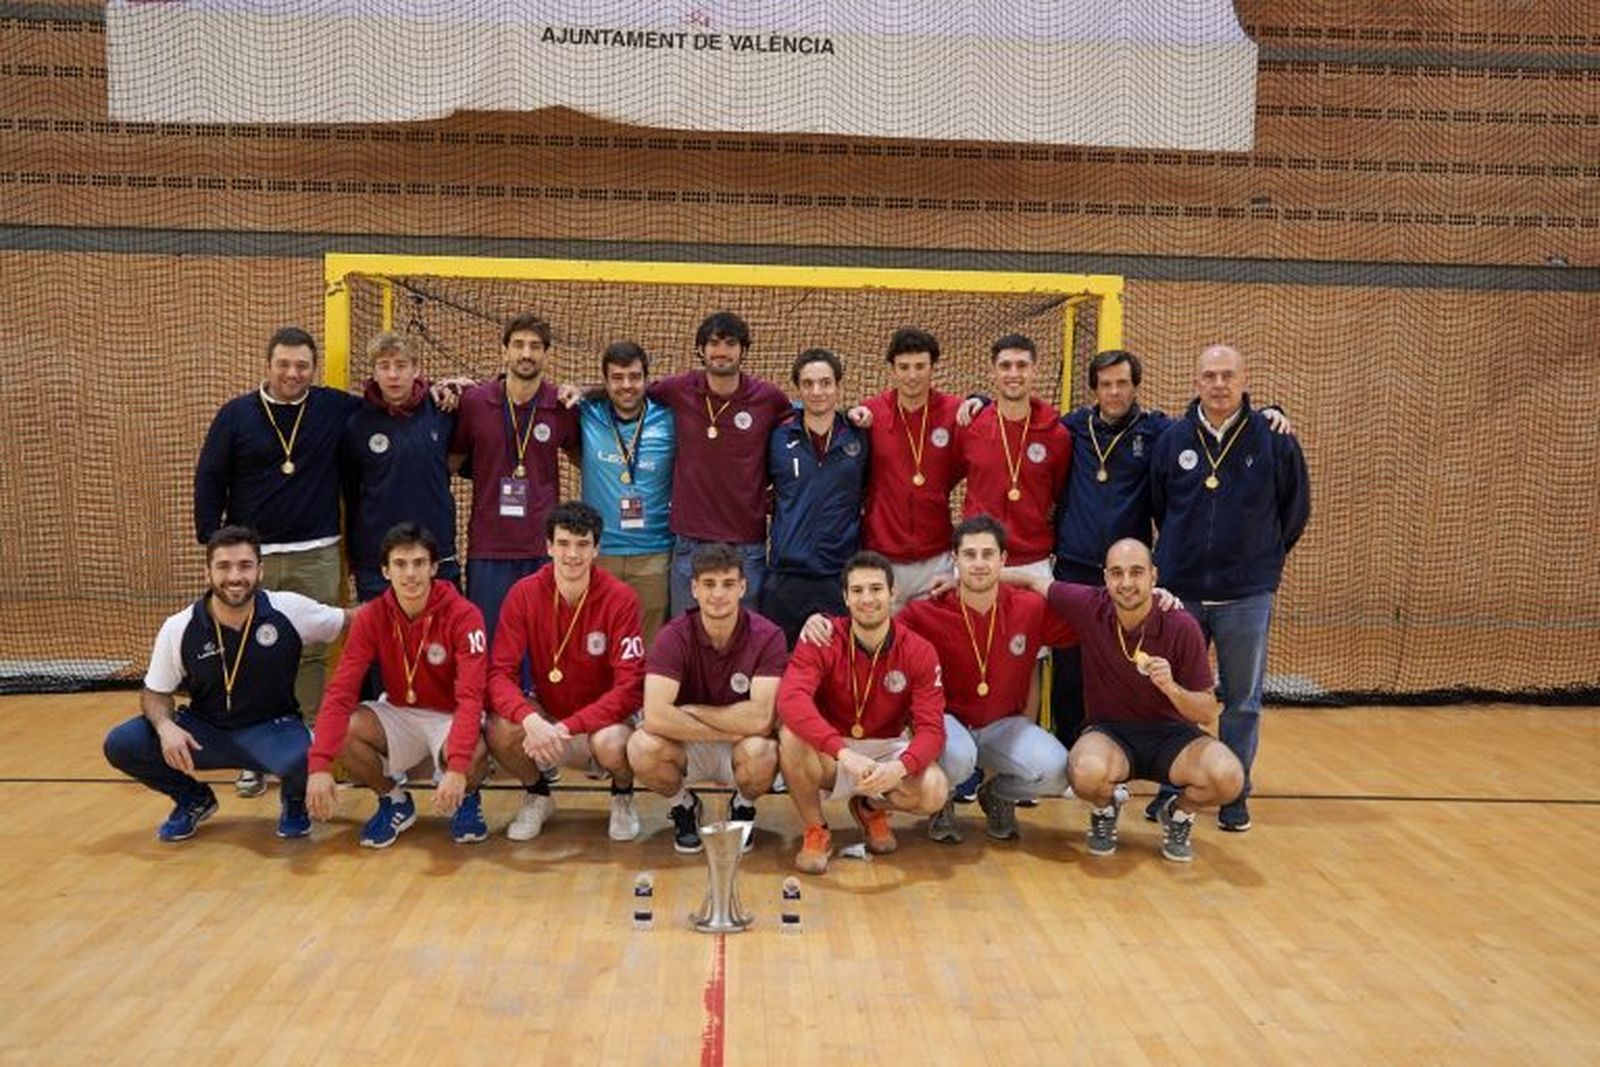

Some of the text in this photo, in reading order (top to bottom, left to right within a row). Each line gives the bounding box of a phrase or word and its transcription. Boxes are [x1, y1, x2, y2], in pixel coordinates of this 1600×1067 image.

[541, 27, 688, 50] AJUNTAMENT
[694, 33, 722, 51] DE
[467, 630, 486, 654] 10
[620, 635, 645, 660] 20
